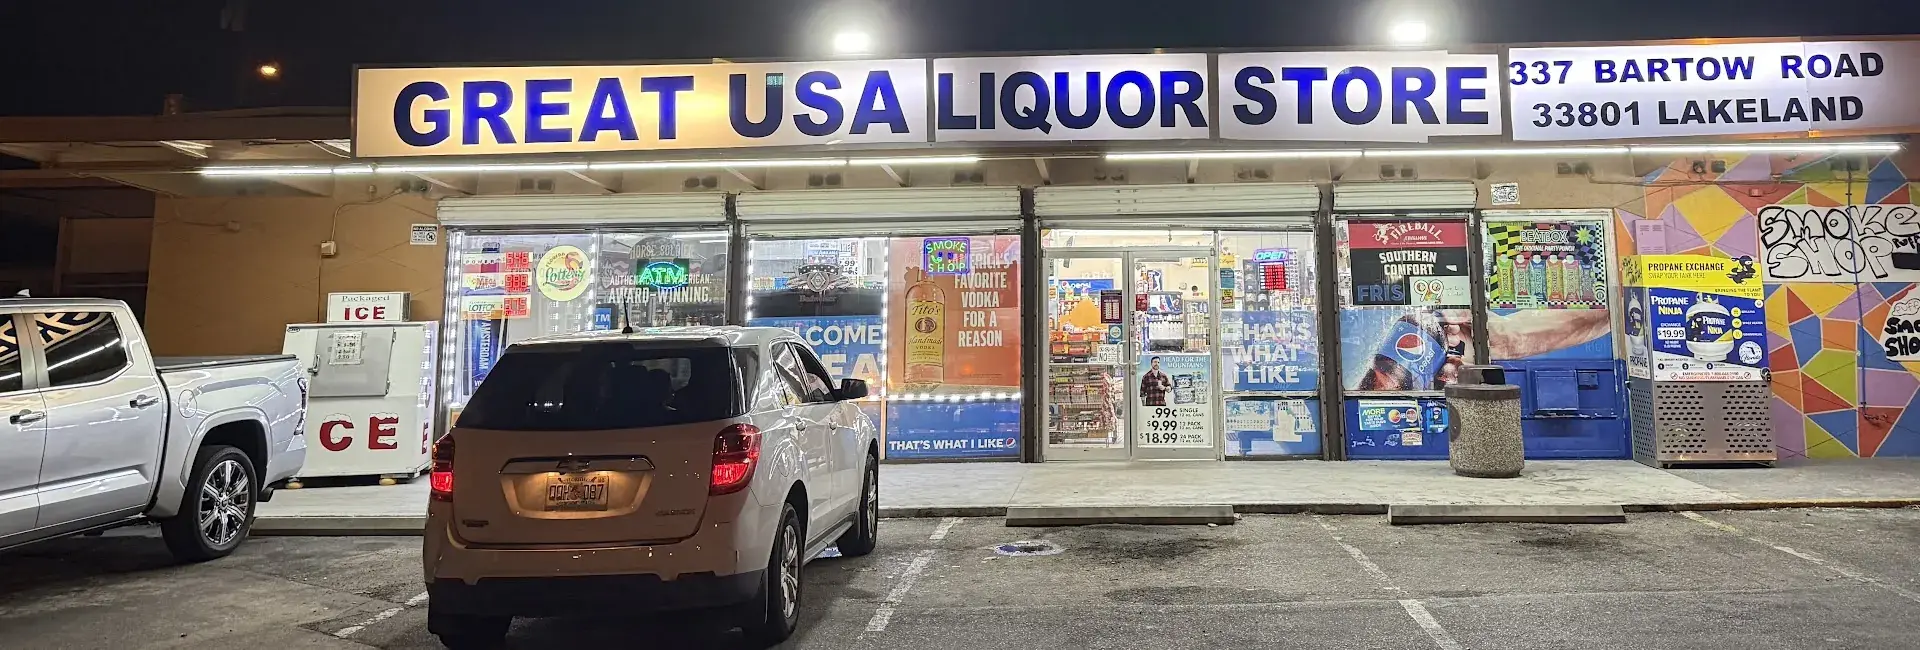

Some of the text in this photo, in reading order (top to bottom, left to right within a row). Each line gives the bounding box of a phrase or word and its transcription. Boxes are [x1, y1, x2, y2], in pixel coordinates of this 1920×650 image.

[1509, 51, 1884, 85] 337 BARTOW ROAD
[937, 70, 1208, 135] LIQUOR
[1232, 66, 1489, 125] STORE
[392, 70, 910, 147] GREAT USA
[1532, 95, 1864, 128] 33801 LAKELAND
[1390, 222, 1442, 241] FIREBALL
[1520, 228, 1569, 244] BEATBOX
[926, 240, 967, 254] SMOKE
[1255, 251, 1286, 260] OPEN
[1378, 250, 1438, 264] SOUTHERN
[1766, 236, 1894, 279] SHOP
[928, 262, 966, 272] SHOP
[1648, 262, 1724, 271] PROPANE EXCHANGE
[544, 267, 586, 286] Lottery
[640, 266, 687, 284] ATM
[954, 272, 1008, 288] FAVORITE
[1357, 284, 1404, 302] FRIS
[1414, 279, 1444, 302] 99
[961, 292, 1000, 308] VODKA
[1651, 296, 1689, 305] PROPANE
[344, 306, 386, 320] ICE
[595, 314, 610, 322] TM
[912, 305, 941, 316] Tito's
[1658, 306, 1684, 315] NINJA
[964, 310, 998, 328] FOR A
[1702, 316, 1726, 326] PROPANE
[783, 325, 882, 346] COME
[1243, 322, 1311, 341] HAT'S
[1657, 329, 1685, 338] $19.99
[1707, 326, 1723, 335] NINJA
[478, 320, 492, 370] AMSTERDAM
[958, 330, 1004, 348] REASON
[1230, 344, 1300, 362] WHAT
[1418, 348, 1436, 374] pepsi
[1234, 366, 1300, 384] I LIKE
[1152, 408, 1178, 419] .99¢
[1362, 408, 1386, 416] MORE
[320, 412, 400, 452] CE
[1146, 420, 1177, 431] $9.99
[888, 438, 1004, 450] THAT'S WHAT I LIKE
[1140, 432, 1178, 444] $18.99
